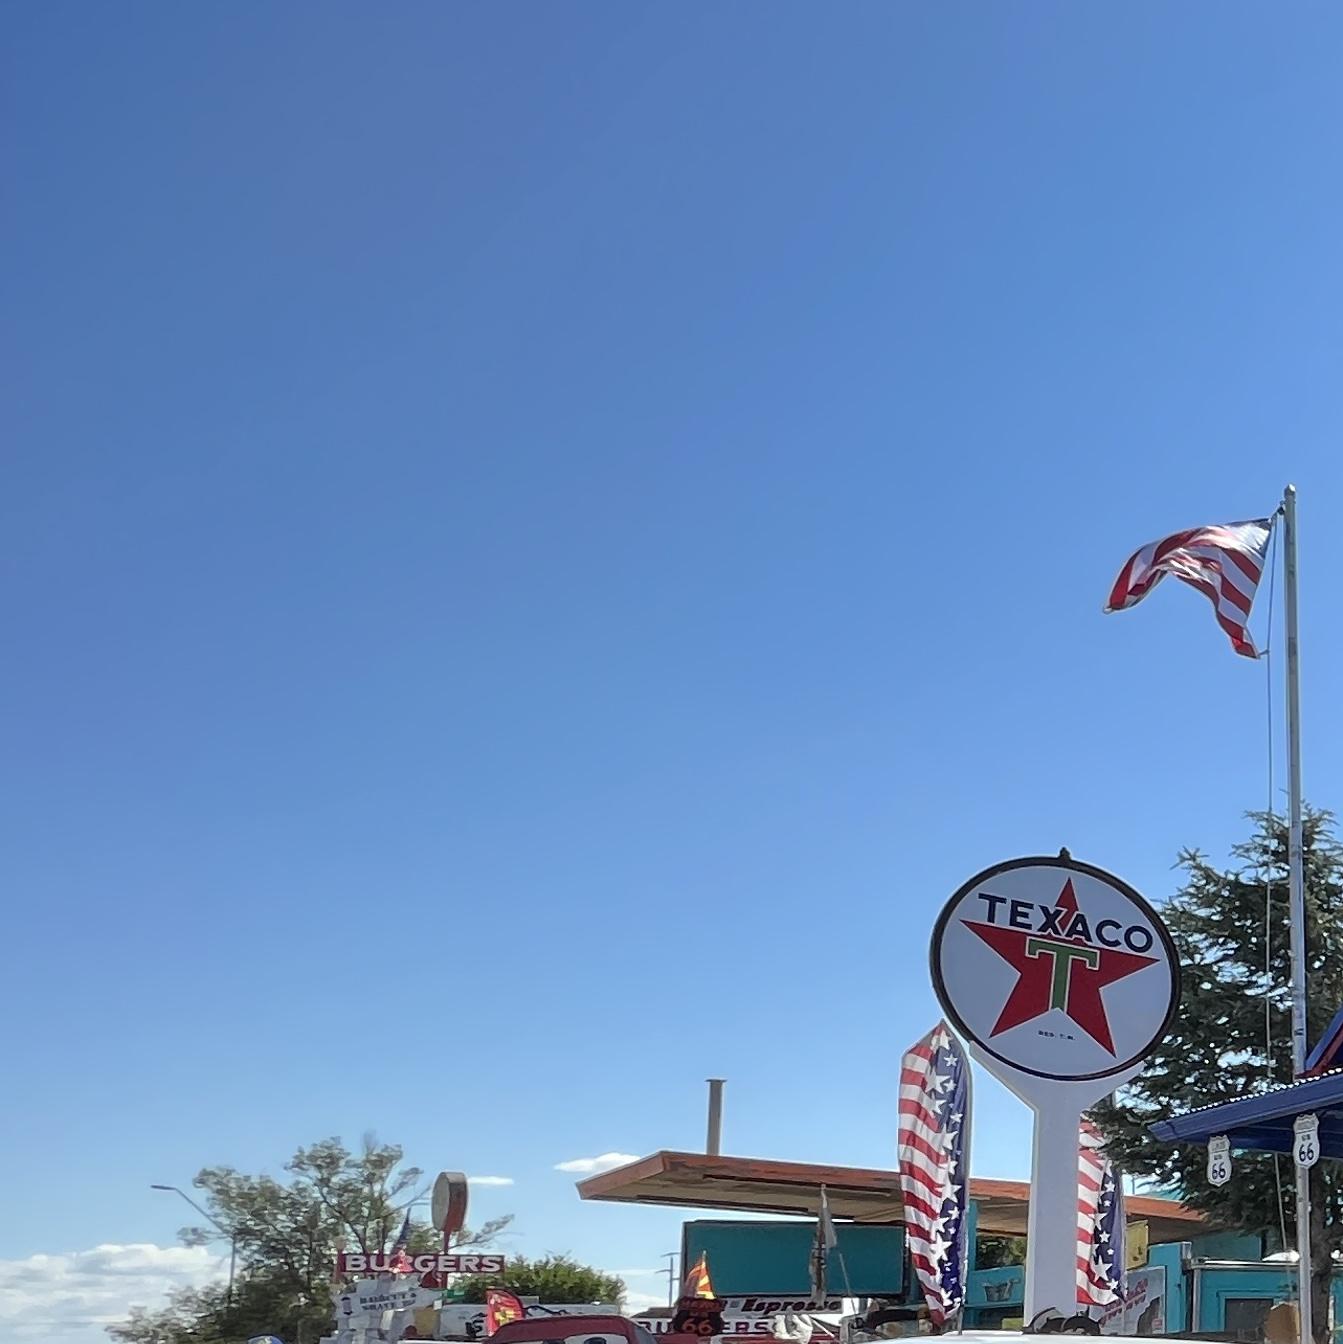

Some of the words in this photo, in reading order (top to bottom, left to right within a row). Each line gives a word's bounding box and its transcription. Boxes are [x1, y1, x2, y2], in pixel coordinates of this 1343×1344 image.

[977, 893, 1154, 953] TEXACO
[1025, 936, 1100, 1012] T
[1211, 1161, 1226, 1180] 66
[1298, 1142, 1314, 1161] 66
